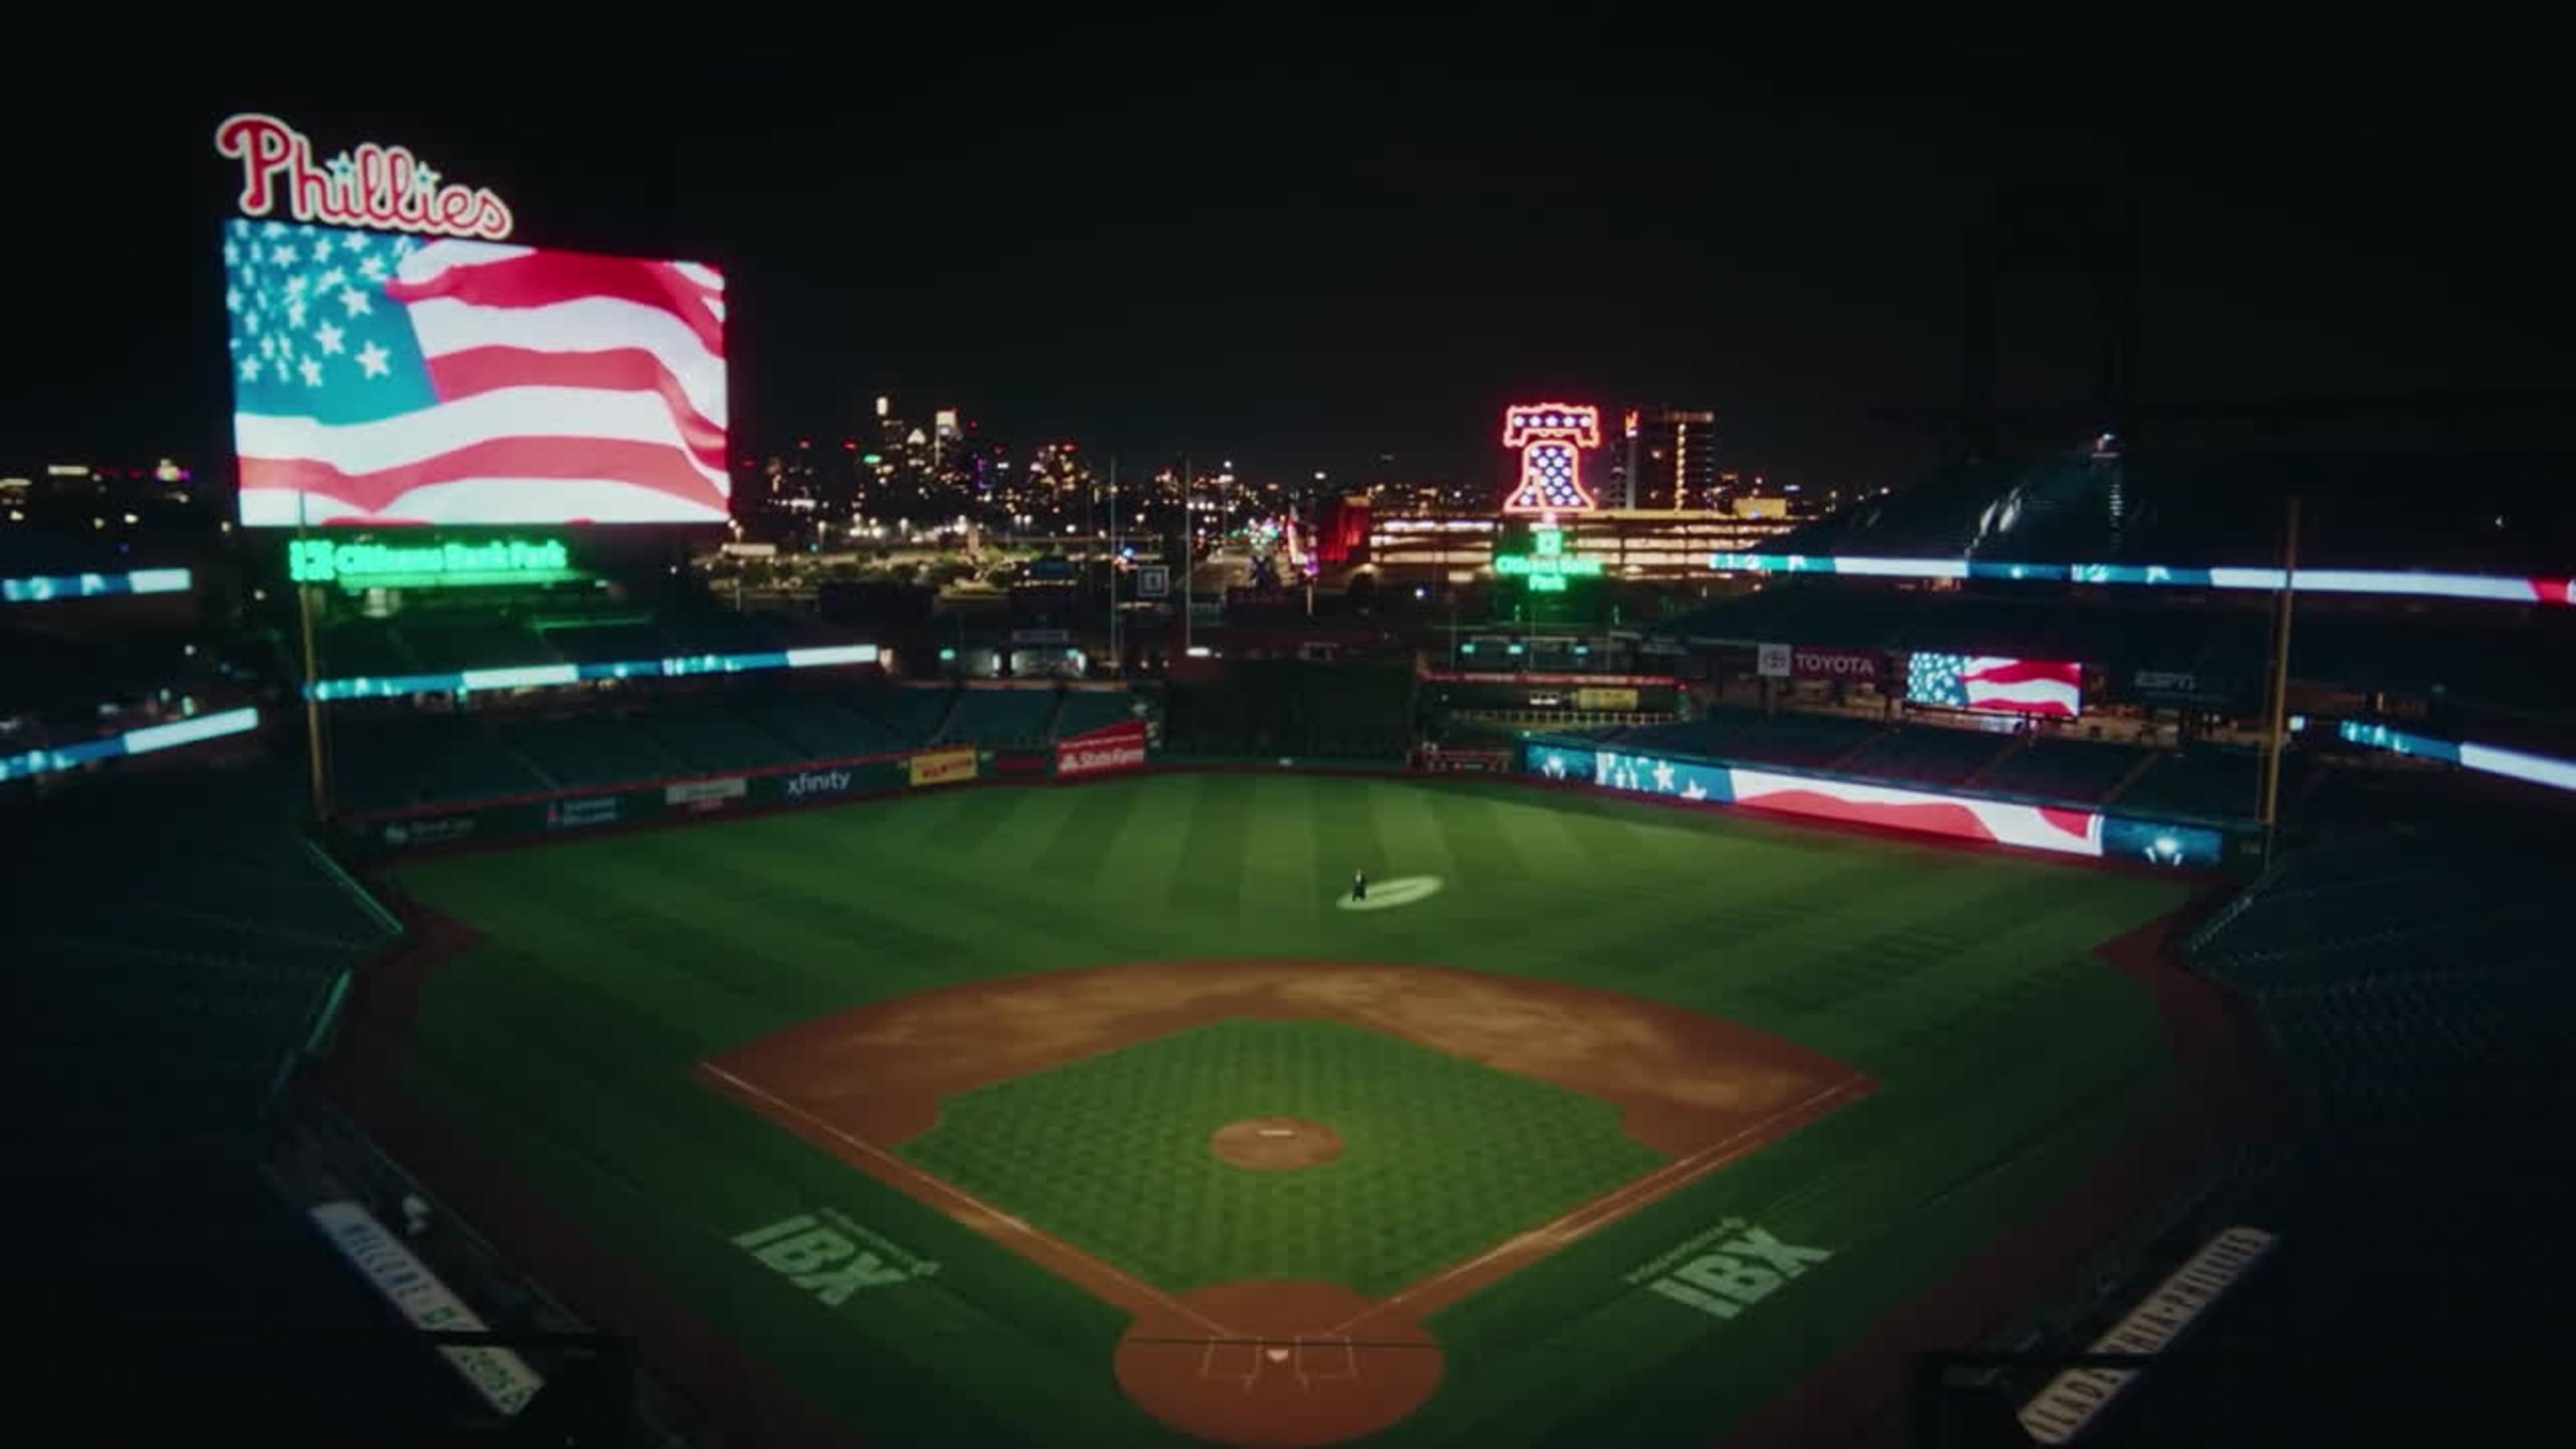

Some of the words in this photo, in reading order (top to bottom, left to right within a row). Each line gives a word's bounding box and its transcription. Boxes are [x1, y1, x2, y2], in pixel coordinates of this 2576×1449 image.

[216, 114, 513, 239] Phillies
[1794, 653, 1875, 676] TOYOTA
[787, 771, 851, 795] xfinity
[730, 1213, 908, 1306] IBX
[1649, 1226, 1834, 1319] IBX
